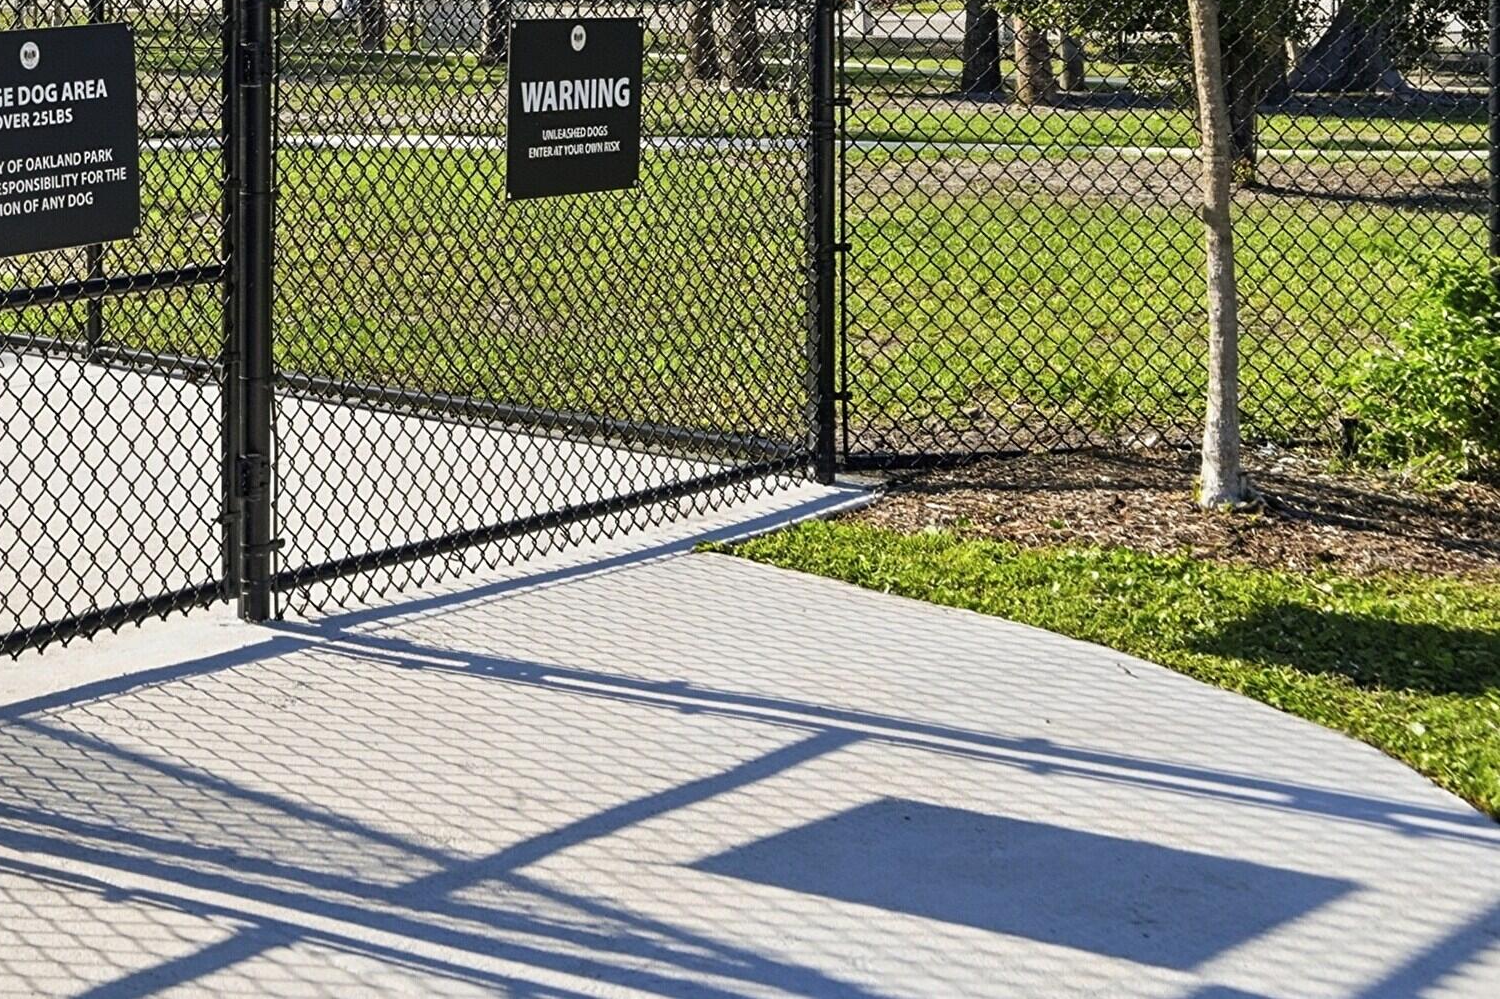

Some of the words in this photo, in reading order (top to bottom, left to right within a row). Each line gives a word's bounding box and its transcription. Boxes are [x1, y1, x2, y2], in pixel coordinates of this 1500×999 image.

[18, 83, 57, 105] DOG
[62, 79, 107, 101] AREA
[521, 77, 629, 112] WARNING
[33, 108, 73, 126] 25LBS
[7, 159, 23, 173] OF
[26, 153, 81, 171] OAKLAND
[84, 149, 112, 164] PARK
[81, 170, 103, 184] FOR
[105, 167, 126, 181] THE
[24, 199, 39, 213] OF
[42, 195, 65, 210] ANY
[68, 192, 93, 207] DOG
